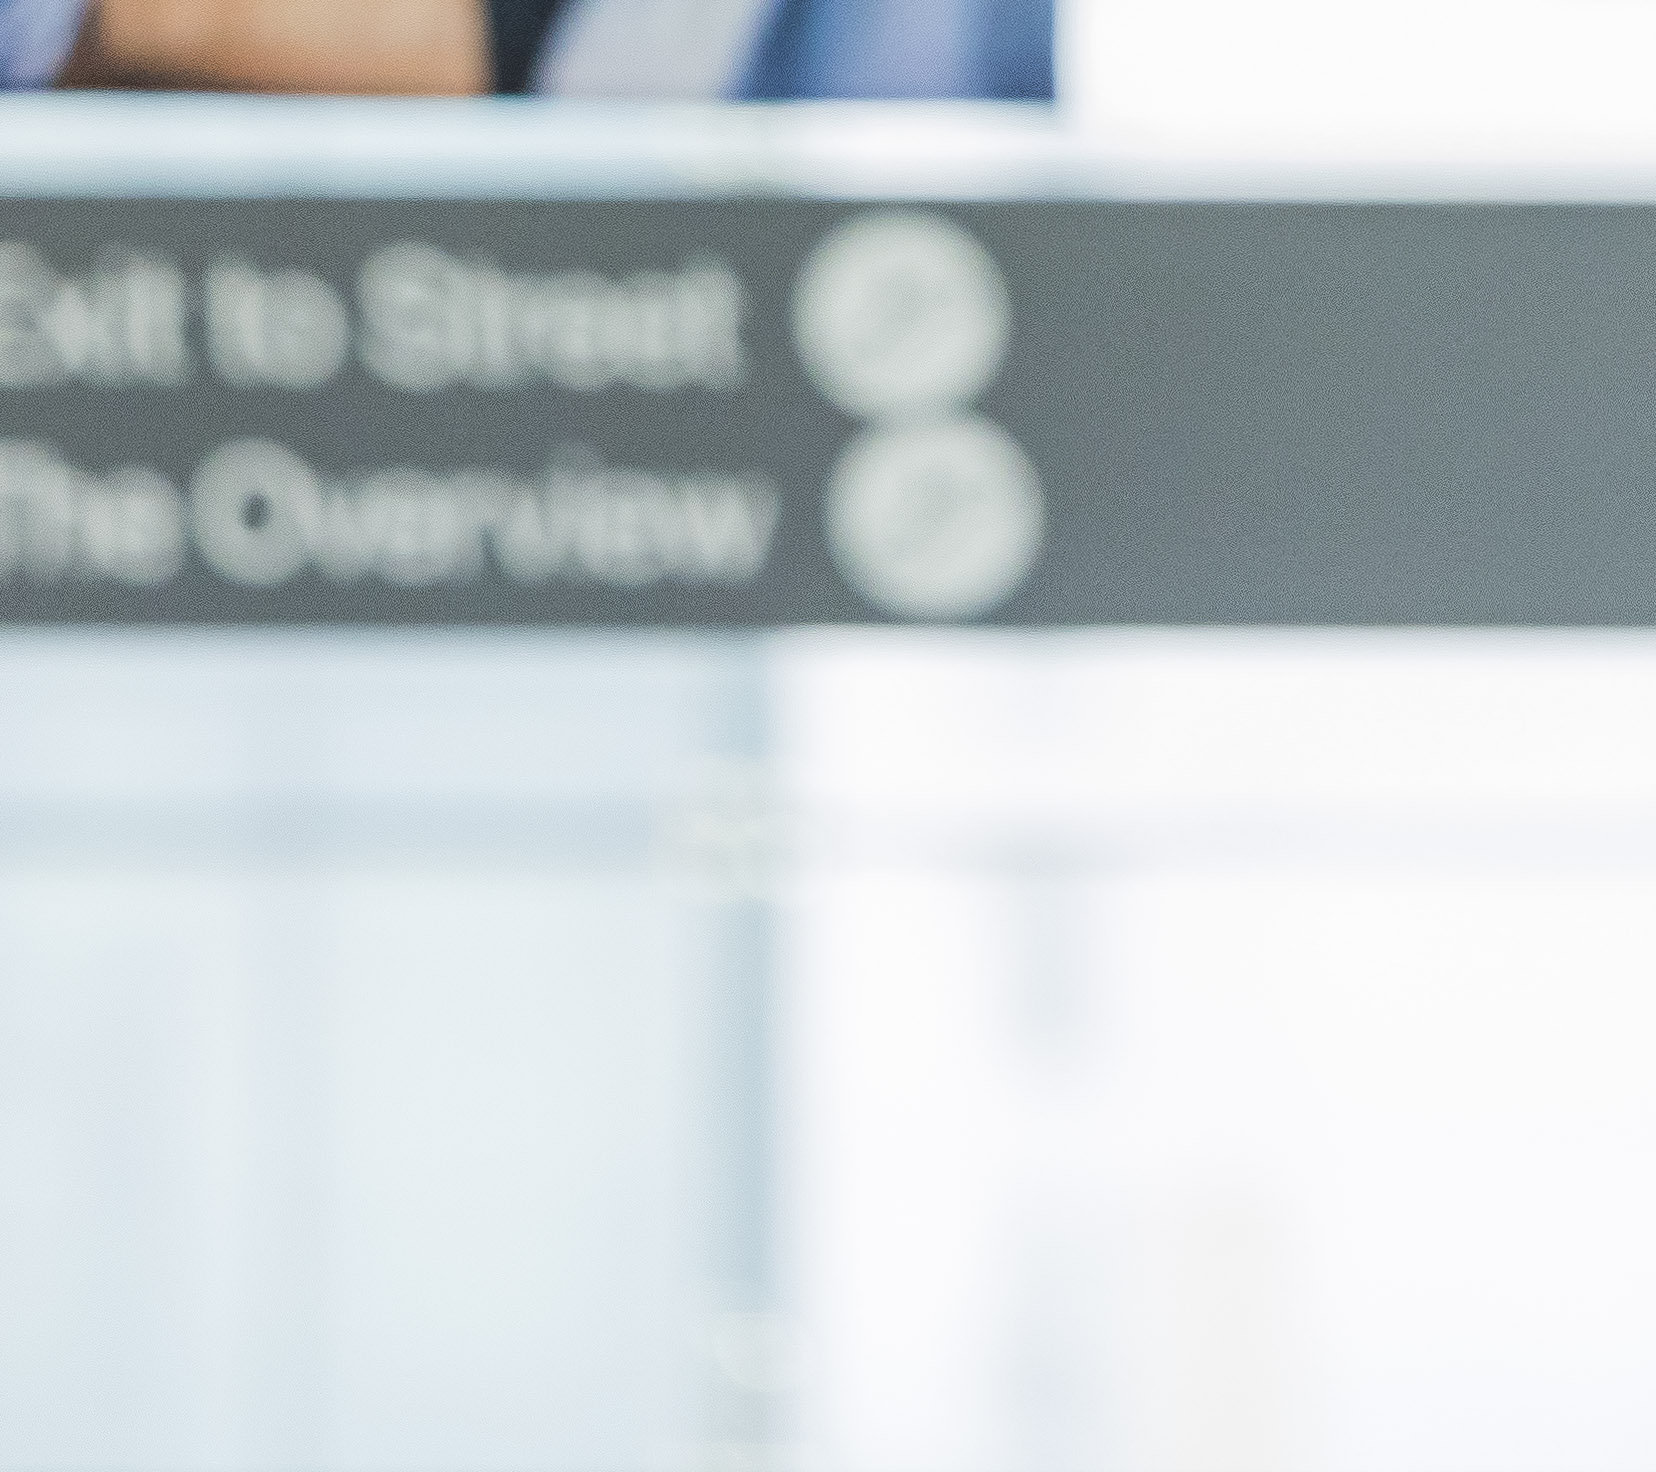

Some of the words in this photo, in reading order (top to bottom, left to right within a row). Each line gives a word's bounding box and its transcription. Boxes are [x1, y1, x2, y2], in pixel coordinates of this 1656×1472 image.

[206, 254, 347, 386] to
[359, 244, 742, 390] Street
[192, 438, 778, 584] Overview
